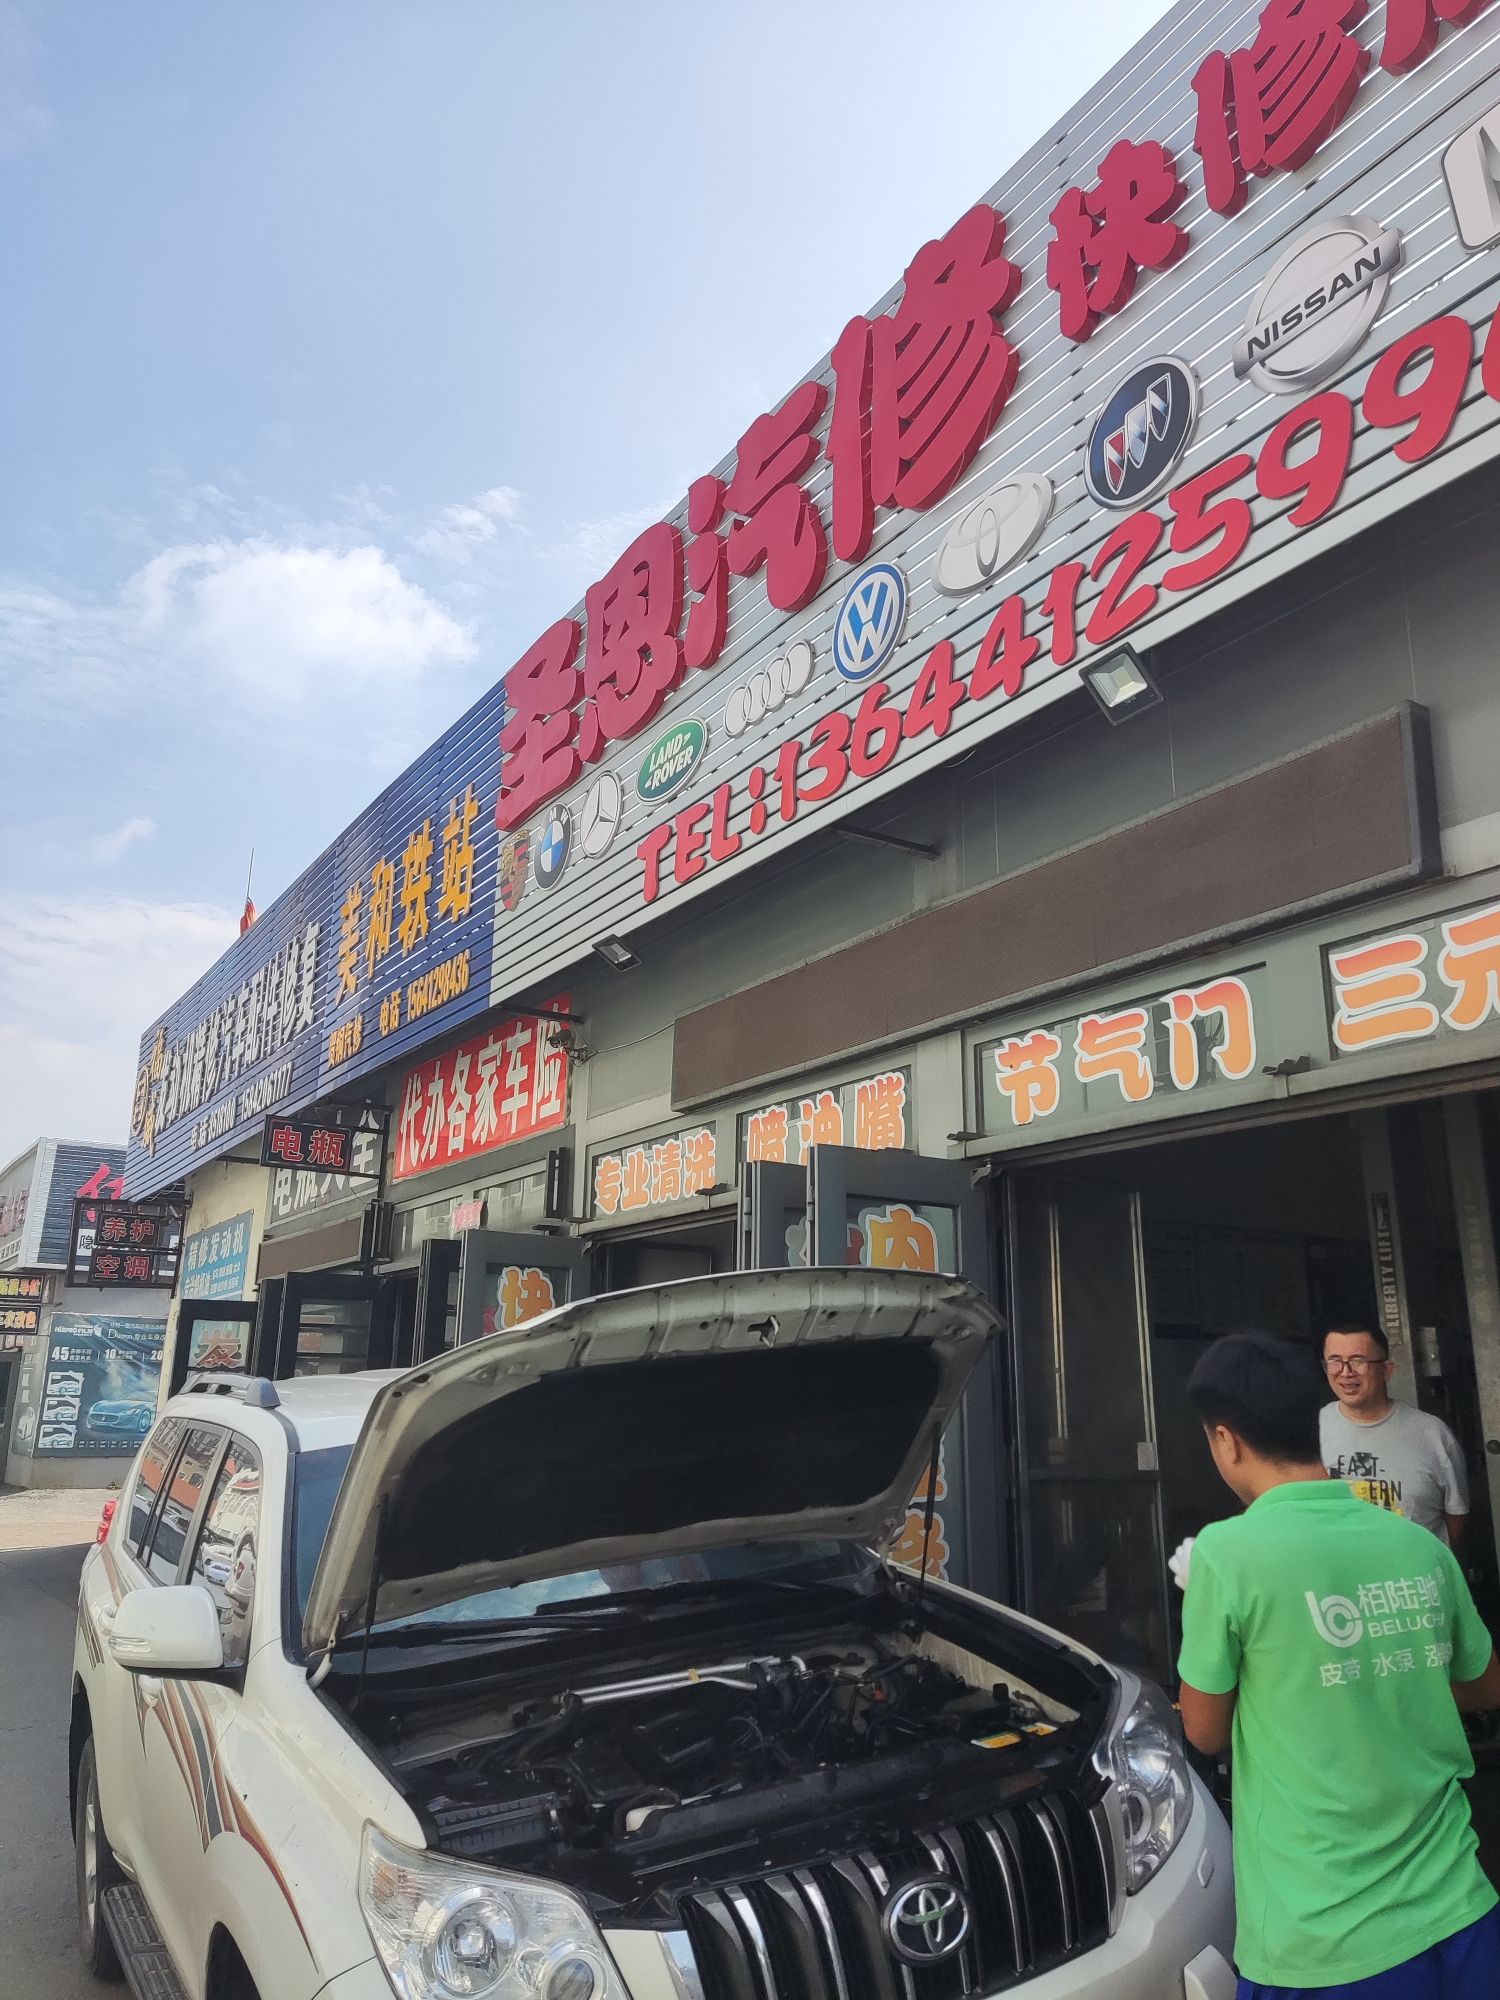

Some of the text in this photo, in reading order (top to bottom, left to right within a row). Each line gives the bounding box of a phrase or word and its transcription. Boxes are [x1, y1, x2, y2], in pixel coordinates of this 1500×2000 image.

[1247, 246, 1382, 360] NISSAN
[379, 989, 401, 1037] 电话
[995, 977, 1257, 1126] 节气门
[399, 1003, 570, 1172] 代办各家车险
[271, 1125, 346, 1167] 电瓶
[594, 1130, 717, 1215] 专业清洗
[102, 1217, 155, 1243] 养护
[187, 1222, 246, 1272] 精修发动机
[94, 1255, 150, 1281] 空调
[1377, 1230, 1401, 1328] LIBERTY LIFT
[51, 1346, 70, 1361] 45
[104, 1348, 117, 1360] 10
[1320, 1658, 1361, 1687] 皮带
[1371, 1648, 1416, 1677] 水泵
